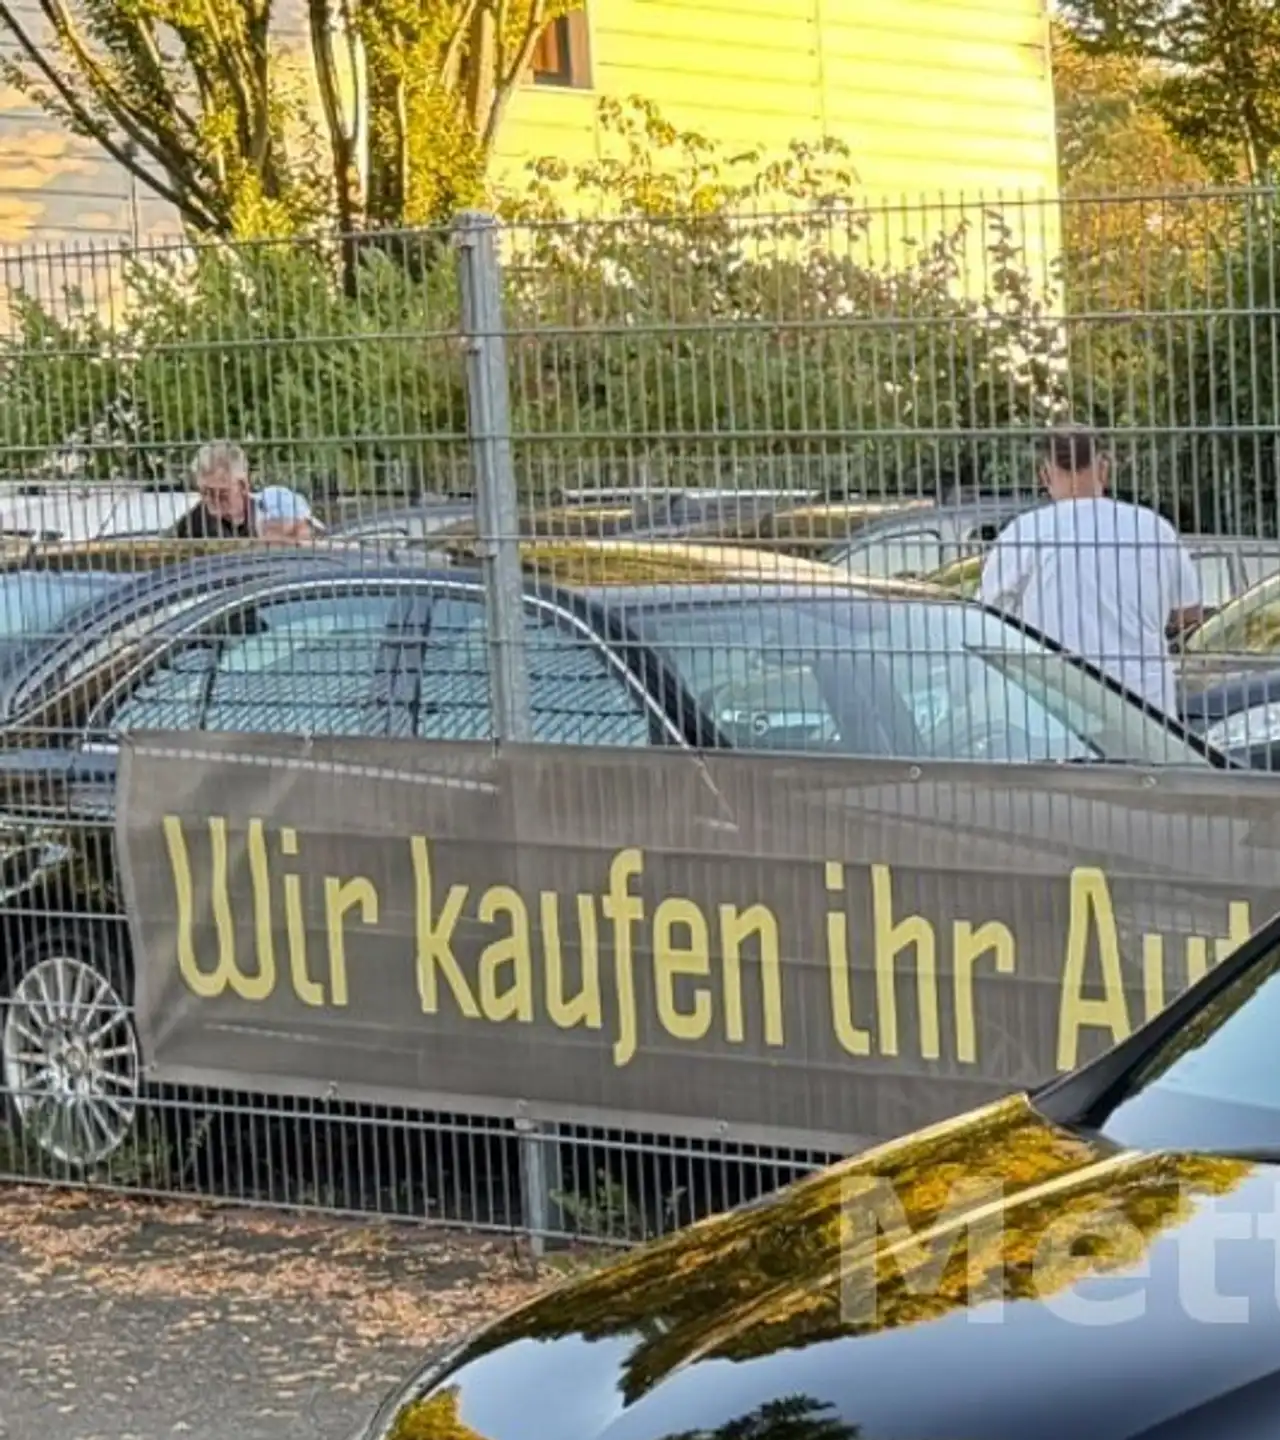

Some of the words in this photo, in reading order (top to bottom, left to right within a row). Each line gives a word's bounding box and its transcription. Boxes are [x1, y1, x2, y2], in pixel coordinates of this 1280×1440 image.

[163, 815, 378, 1006] Wir
[410, 847, 784, 1067] kaufen
[825, 861, 1015, 1064] ihr
